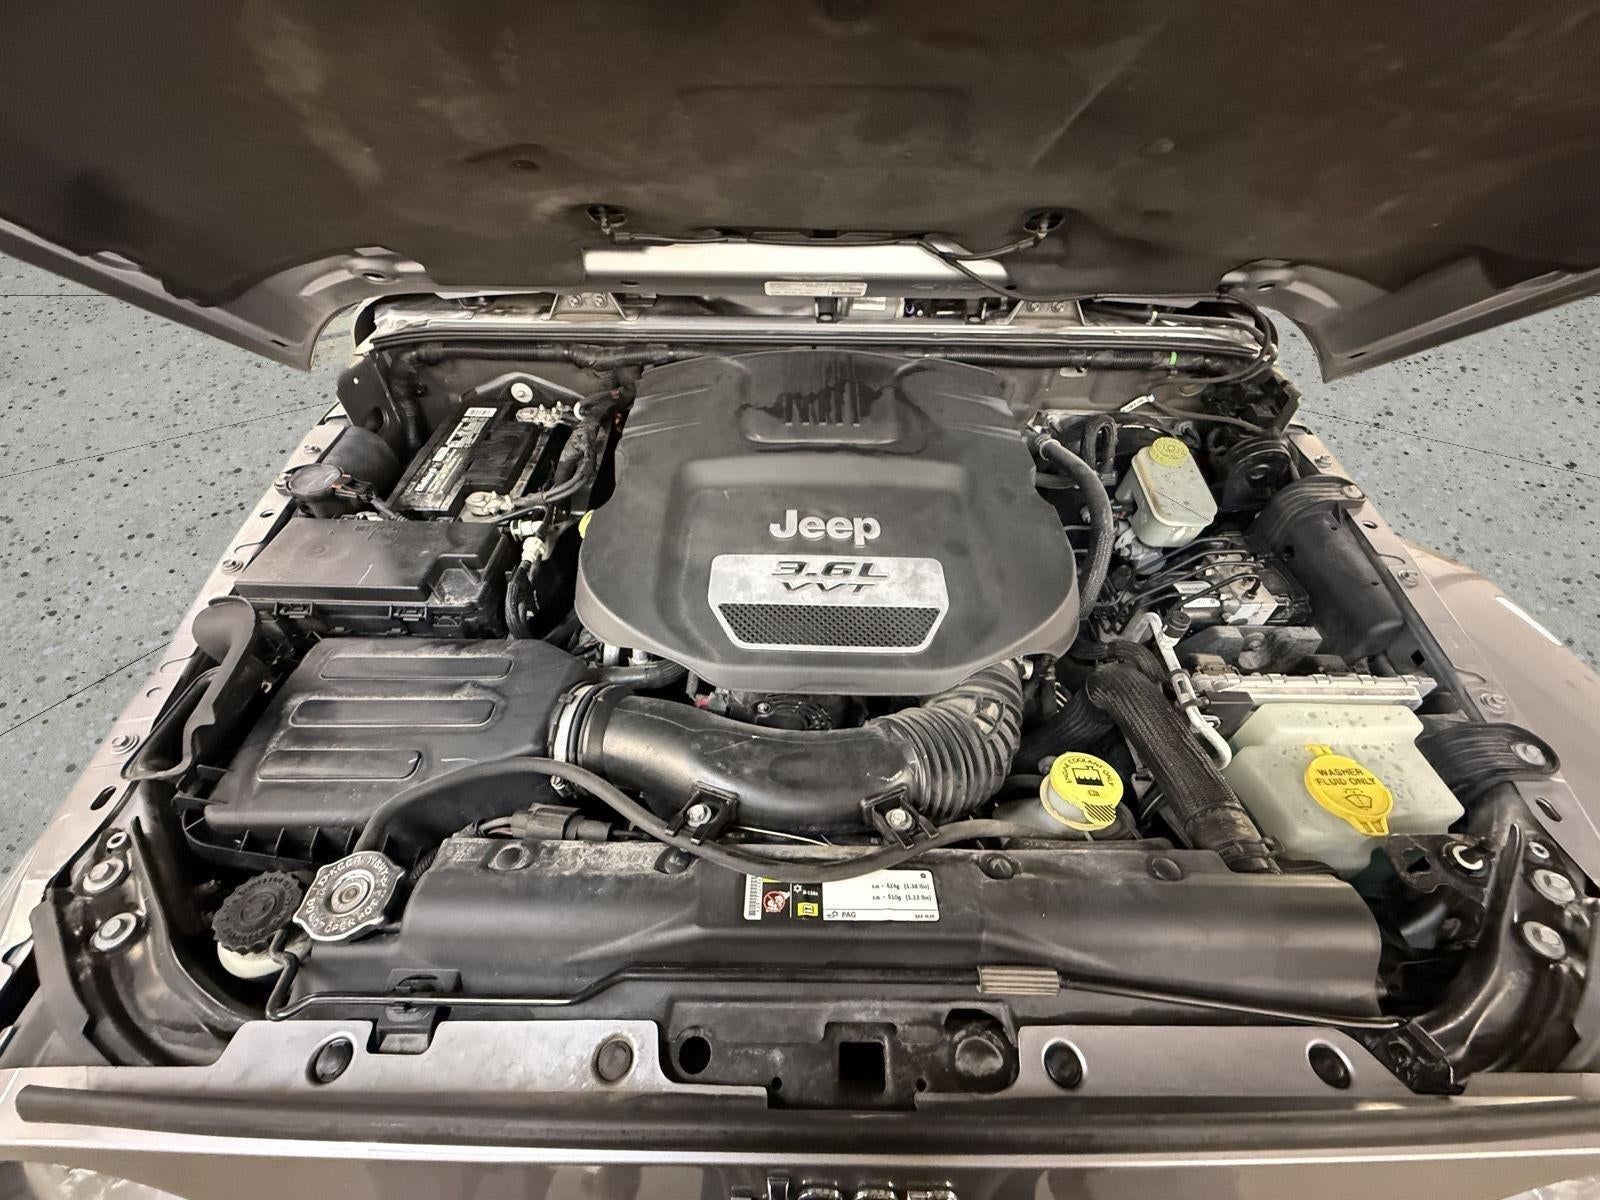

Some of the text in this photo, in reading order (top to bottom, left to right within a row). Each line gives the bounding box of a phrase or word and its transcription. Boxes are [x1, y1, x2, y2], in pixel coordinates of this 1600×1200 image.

[769, 509, 881, 547] Jeep
[771, 560, 889, 577] 3.6L
[780, 581, 876, 593] VVT
[1316, 768, 1364, 777] WASHER
[1315, 777, 1376, 786] FLUID ONLY
